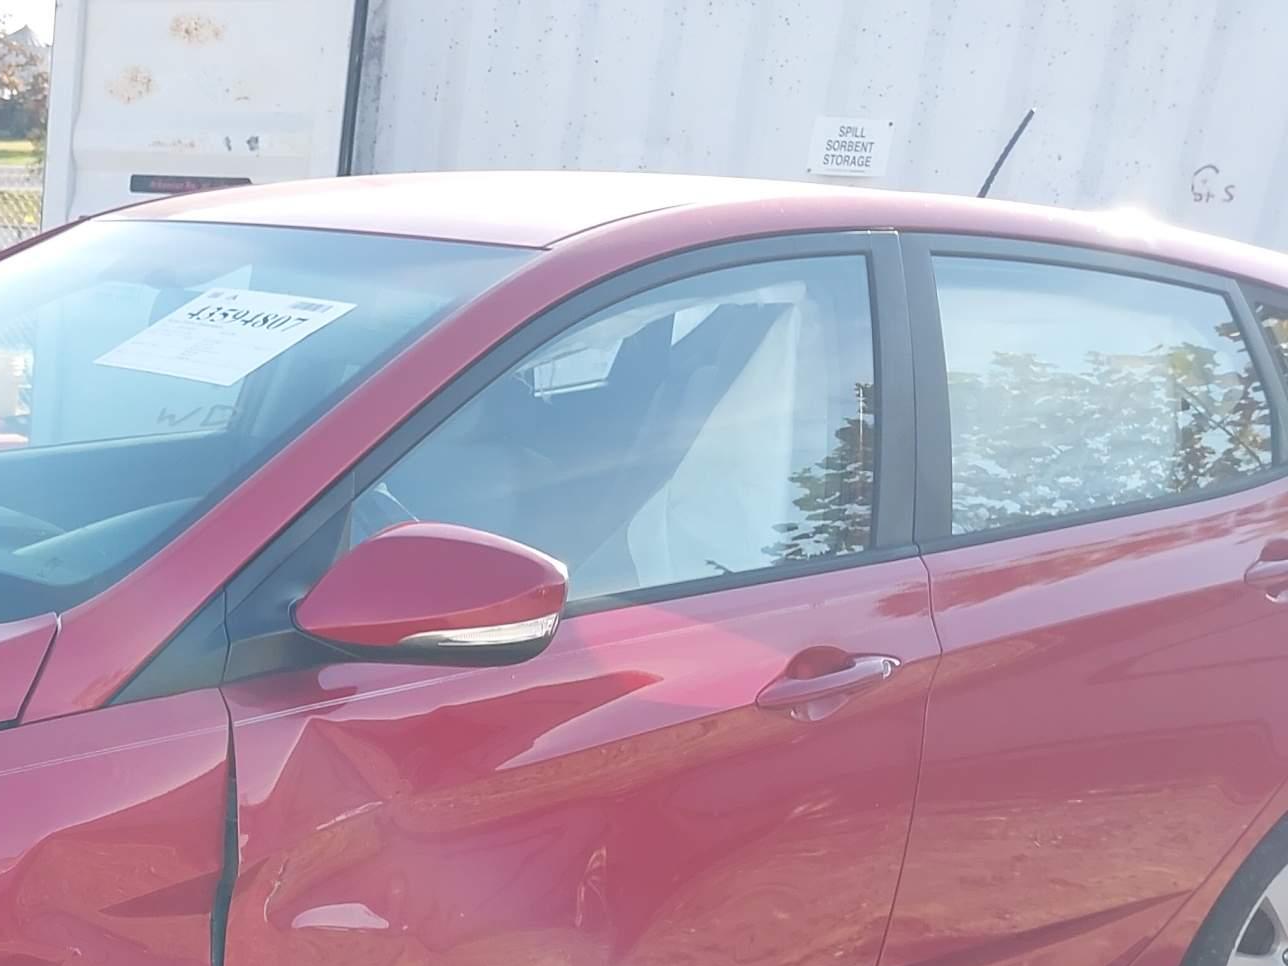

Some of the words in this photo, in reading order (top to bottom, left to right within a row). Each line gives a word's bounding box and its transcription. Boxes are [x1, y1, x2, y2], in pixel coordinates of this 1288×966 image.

[838, 125, 866, 138] SPILL
[825, 139, 875, 153] SORBENT
[822, 153, 872, 168] STORAGE
[187, 305, 310, 332] 43594807
